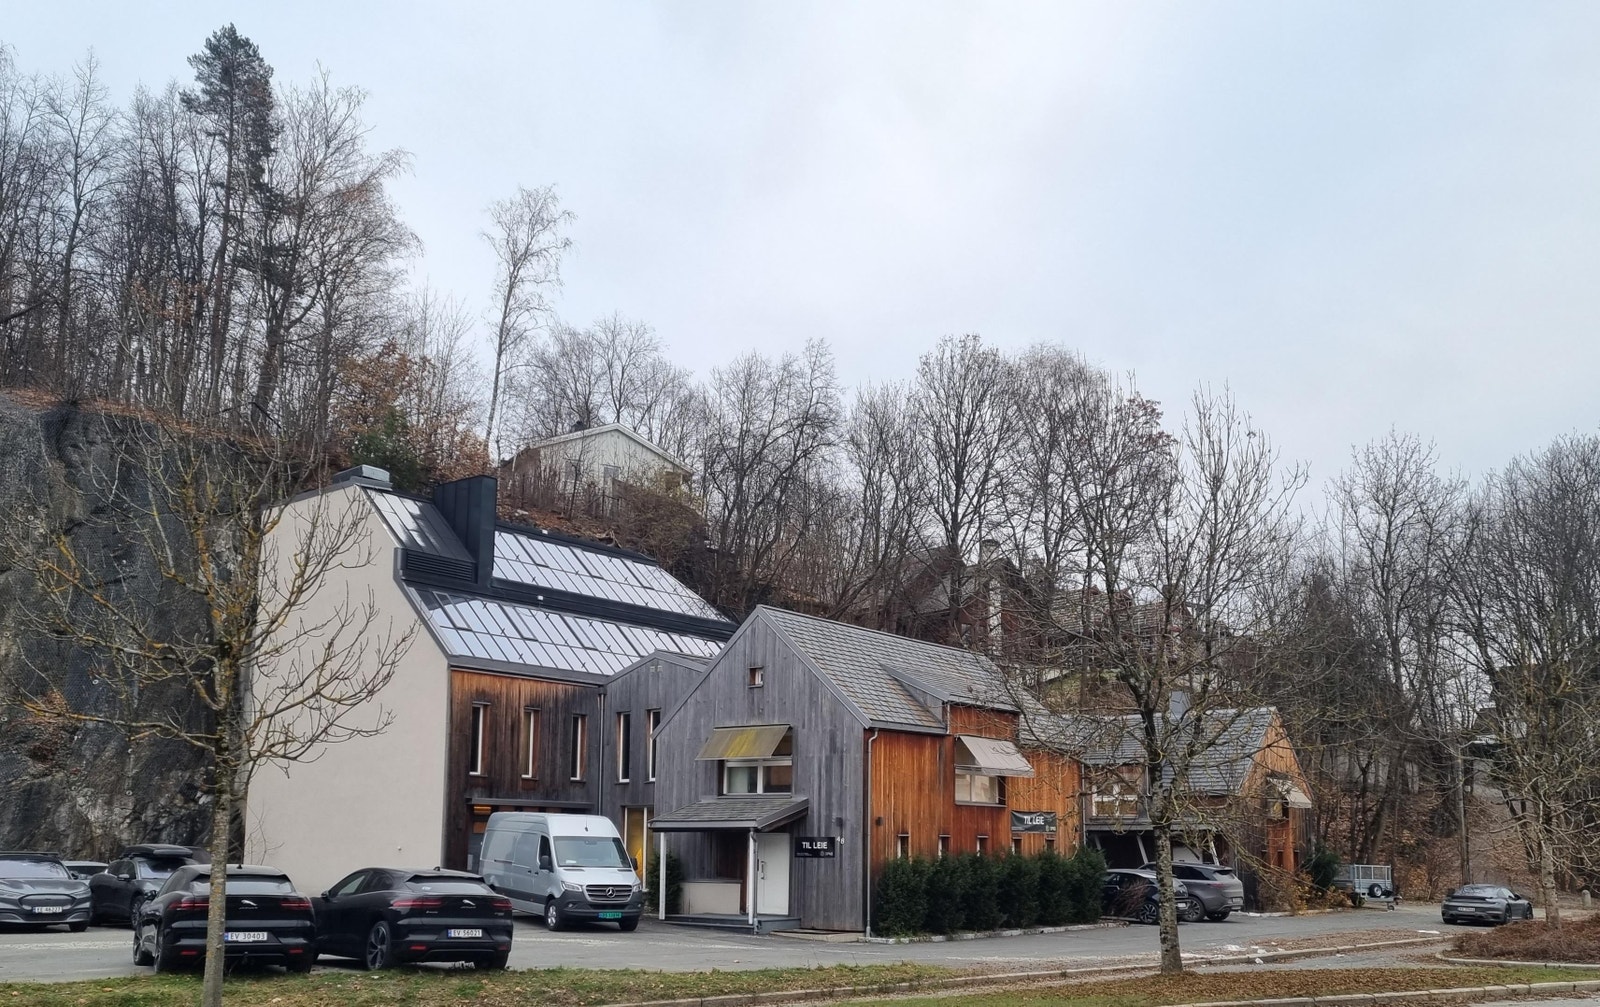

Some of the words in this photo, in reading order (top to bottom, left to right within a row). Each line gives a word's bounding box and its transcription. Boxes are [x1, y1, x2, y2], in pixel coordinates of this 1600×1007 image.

[1024, 816, 1032, 825] TIL
[1032, 816, 1045, 825] LEIE
[802, 841, 812, 849] TIL
[813, 841, 828, 849] LEIE
[230, 932, 240, 940] EV
[243, 932, 265, 940] 30403
[453, 929, 461, 937] EV
[463, 929, 481, 937] 56021
